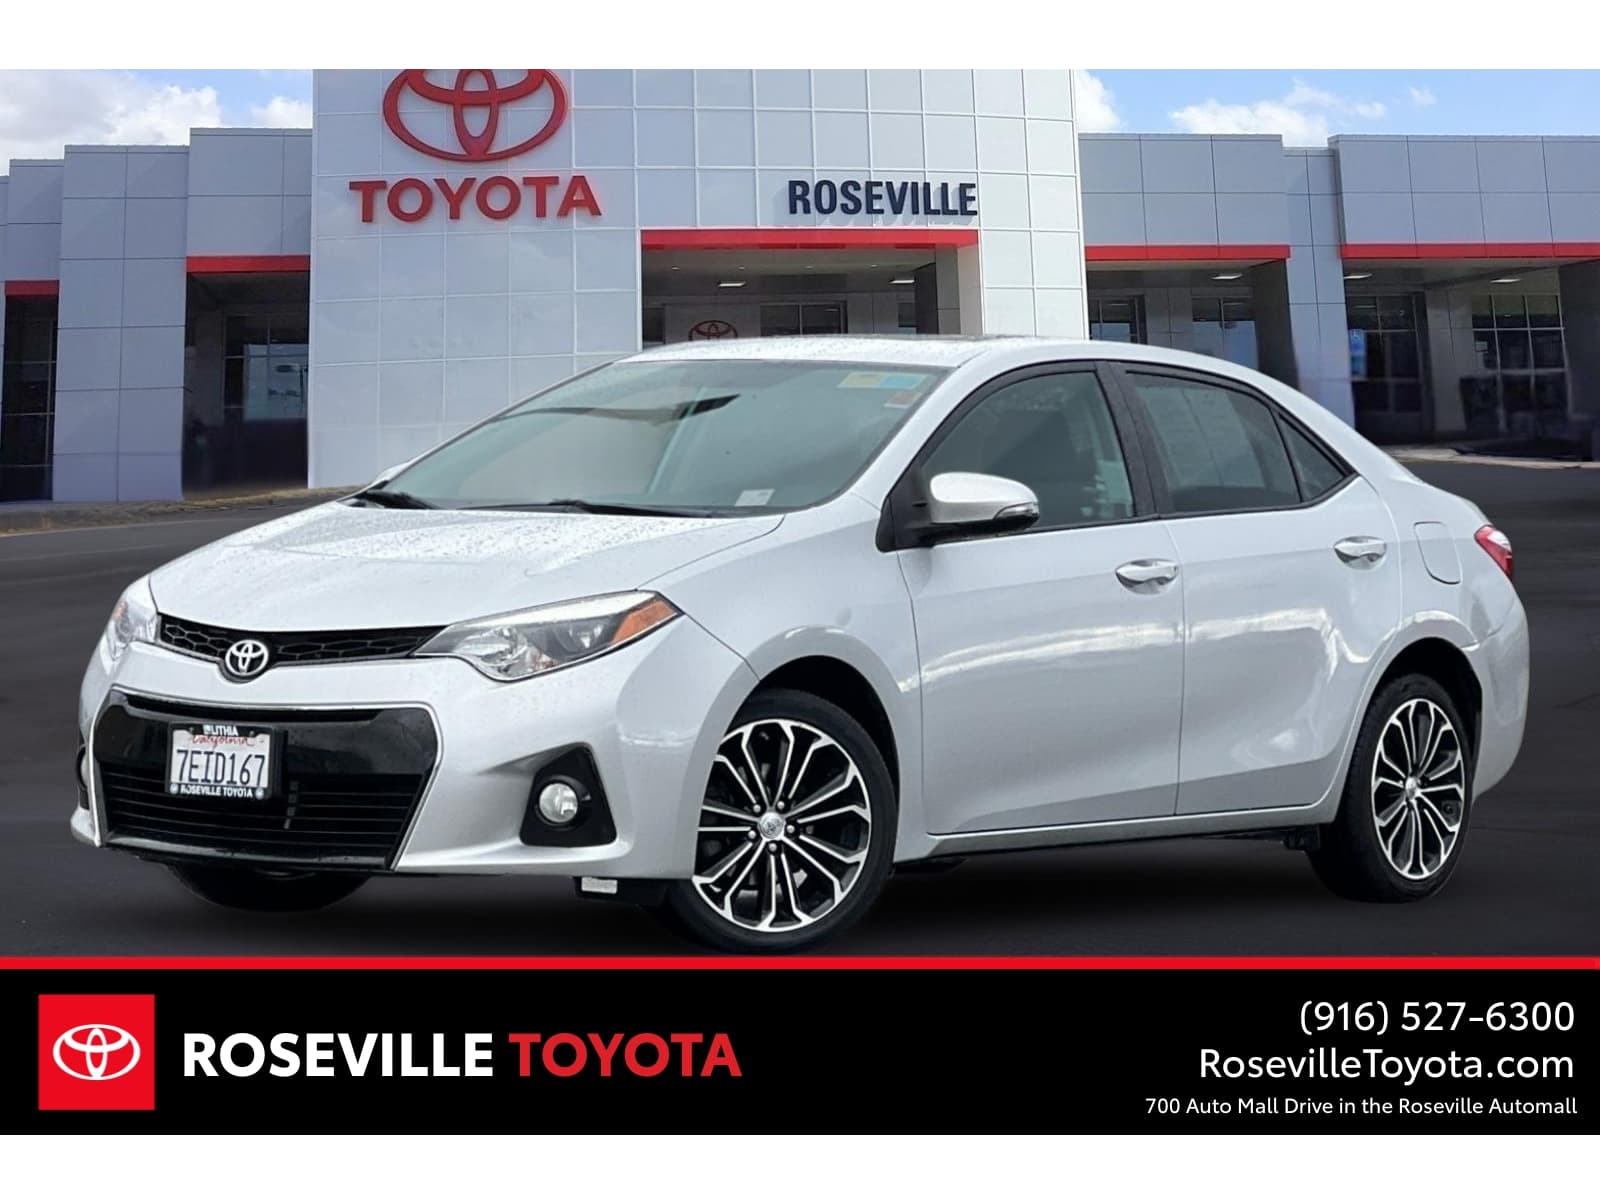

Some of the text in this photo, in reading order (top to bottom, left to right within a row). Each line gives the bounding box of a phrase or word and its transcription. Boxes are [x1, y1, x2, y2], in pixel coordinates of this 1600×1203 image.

[349, 175, 602, 222] TOYOTA
[788, 180, 978, 216] ROSEVILLE
[176, 748, 265, 788] 7EID167
[180, 784, 254, 798] ROSEVILLE TOYOTA
